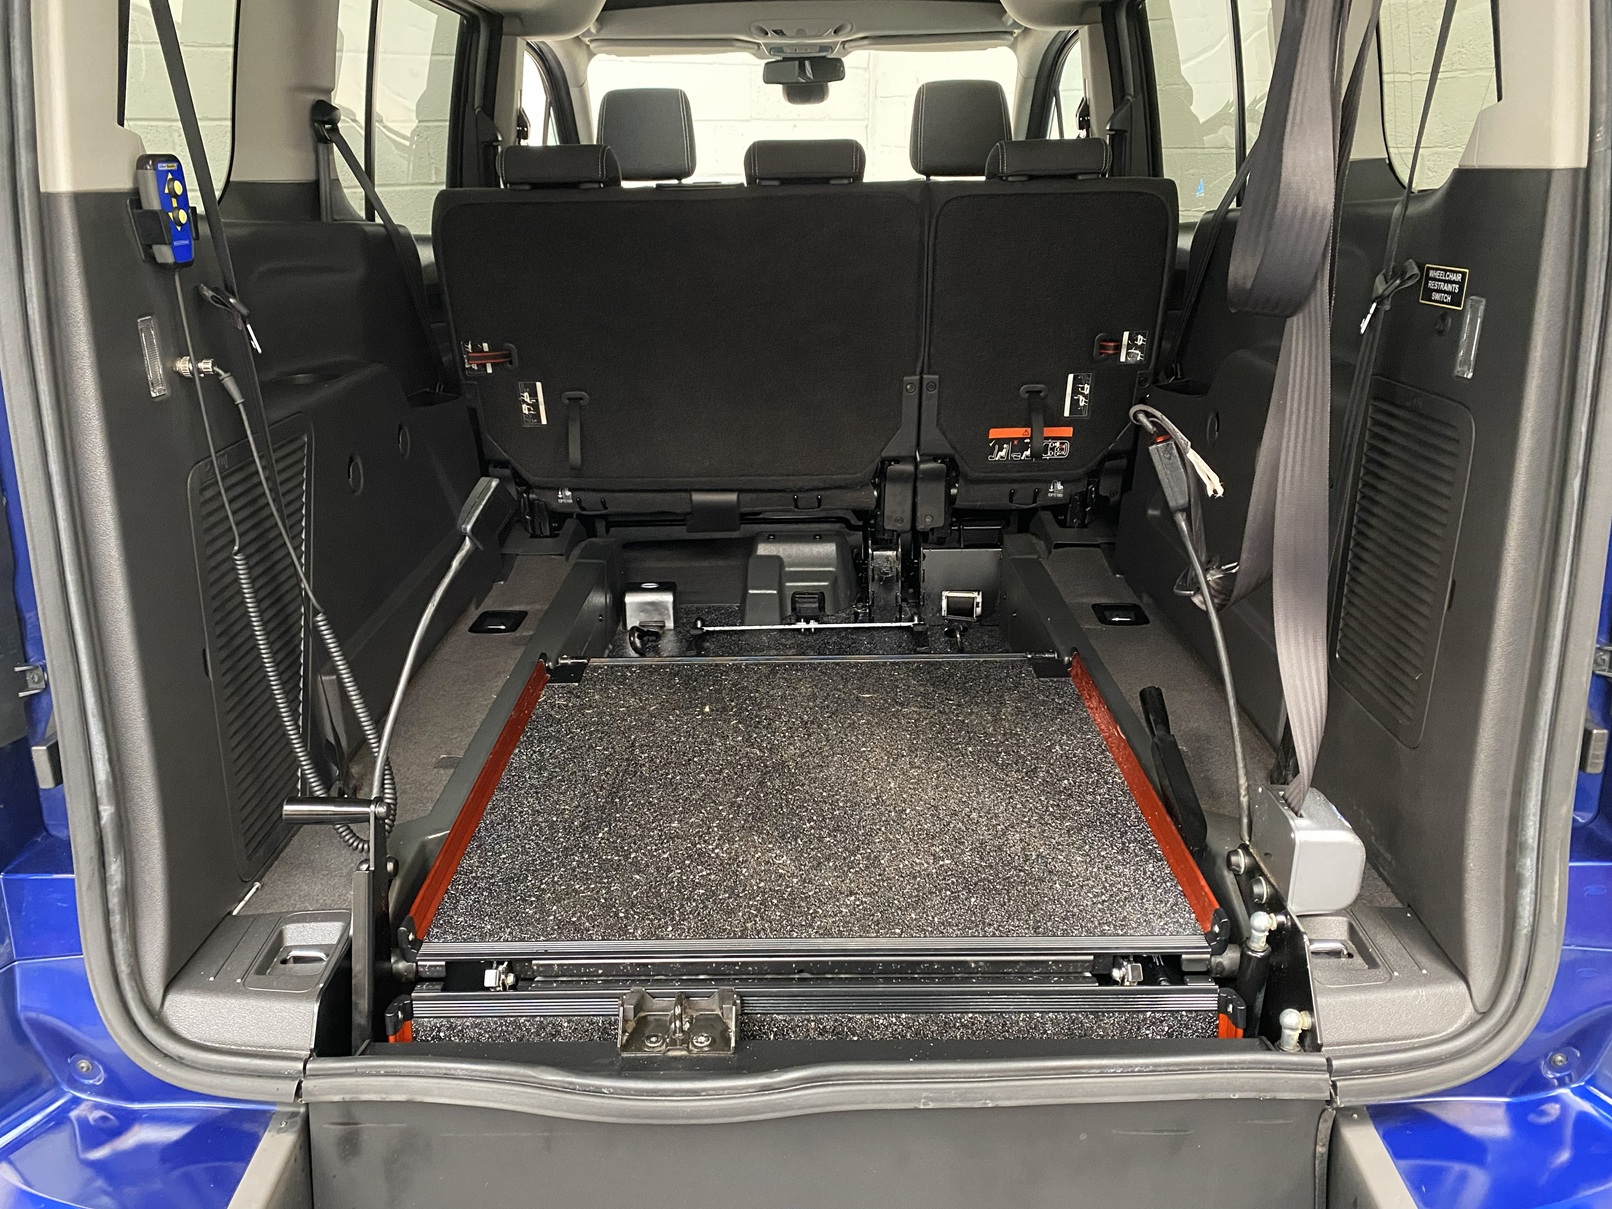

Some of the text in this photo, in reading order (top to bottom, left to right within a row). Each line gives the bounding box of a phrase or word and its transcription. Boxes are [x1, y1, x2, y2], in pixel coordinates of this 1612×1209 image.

[1429, 269, 1462, 282] WHEELCHAIR
[1428, 280, 1459, 293] RESTRAINTS
[1431, 291, 1452, 303] SWITCH
